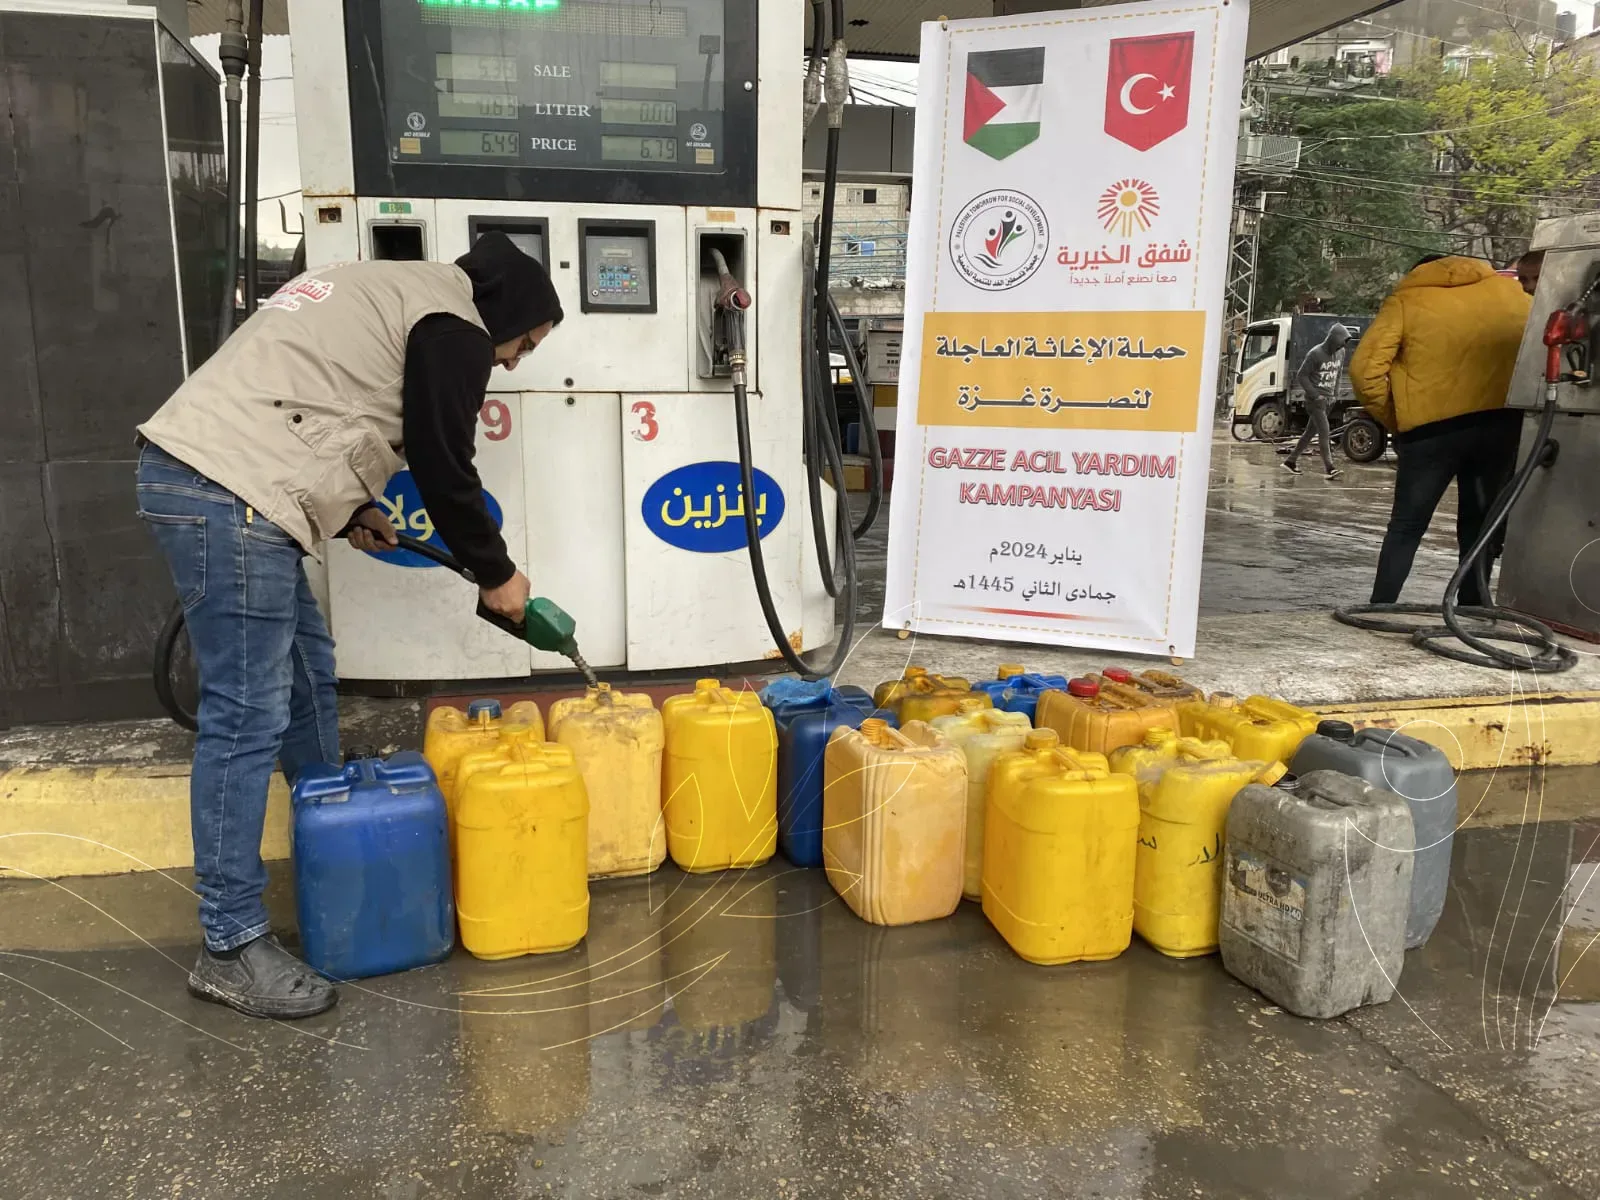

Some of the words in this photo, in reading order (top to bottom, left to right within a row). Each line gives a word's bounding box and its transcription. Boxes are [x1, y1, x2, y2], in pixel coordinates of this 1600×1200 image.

[533, 64, 571, 79] SALE
[534, 102, 591, 118] LITER
[481, 133, 517, 154] 6.49
[531, 136, 577, 152] PRICE
[640, 139, 675, 159] 6.79
[955, 213, 972, 238] PALESTINE
[970, 196, 997, 214] TOMORROW
[1009, 196, 1026, 207] SOCIAL
[1025, 203, 1045, 236] DEVELOPMENT
[1057, 244, 1131, 270] الخيرية
[1137, 239, 1192, 268] شفق
[1127, 273, 1154, 286] نصنع
[935, 334, 1021, 364] العاجلة
[1024, 335, 1114, 364] الإغاثة
[1117, 335, 1188, 360] حملة
[957, 384, 1037, 412] غزة
[1039, 385, 1152, 413] لنصرة
[479, 398, 512, 442] 9
[631, 401, 659, 442] 3
[928, 447, 1006, 471] GAZZE
[1072, 450, 1177, 478] YARDIM
[959, 482, 1122, 512] KAMPANYASI
[1021, 579, 1061, 602] الثاني
[1257, 891, 1278, 906] ULTRA
